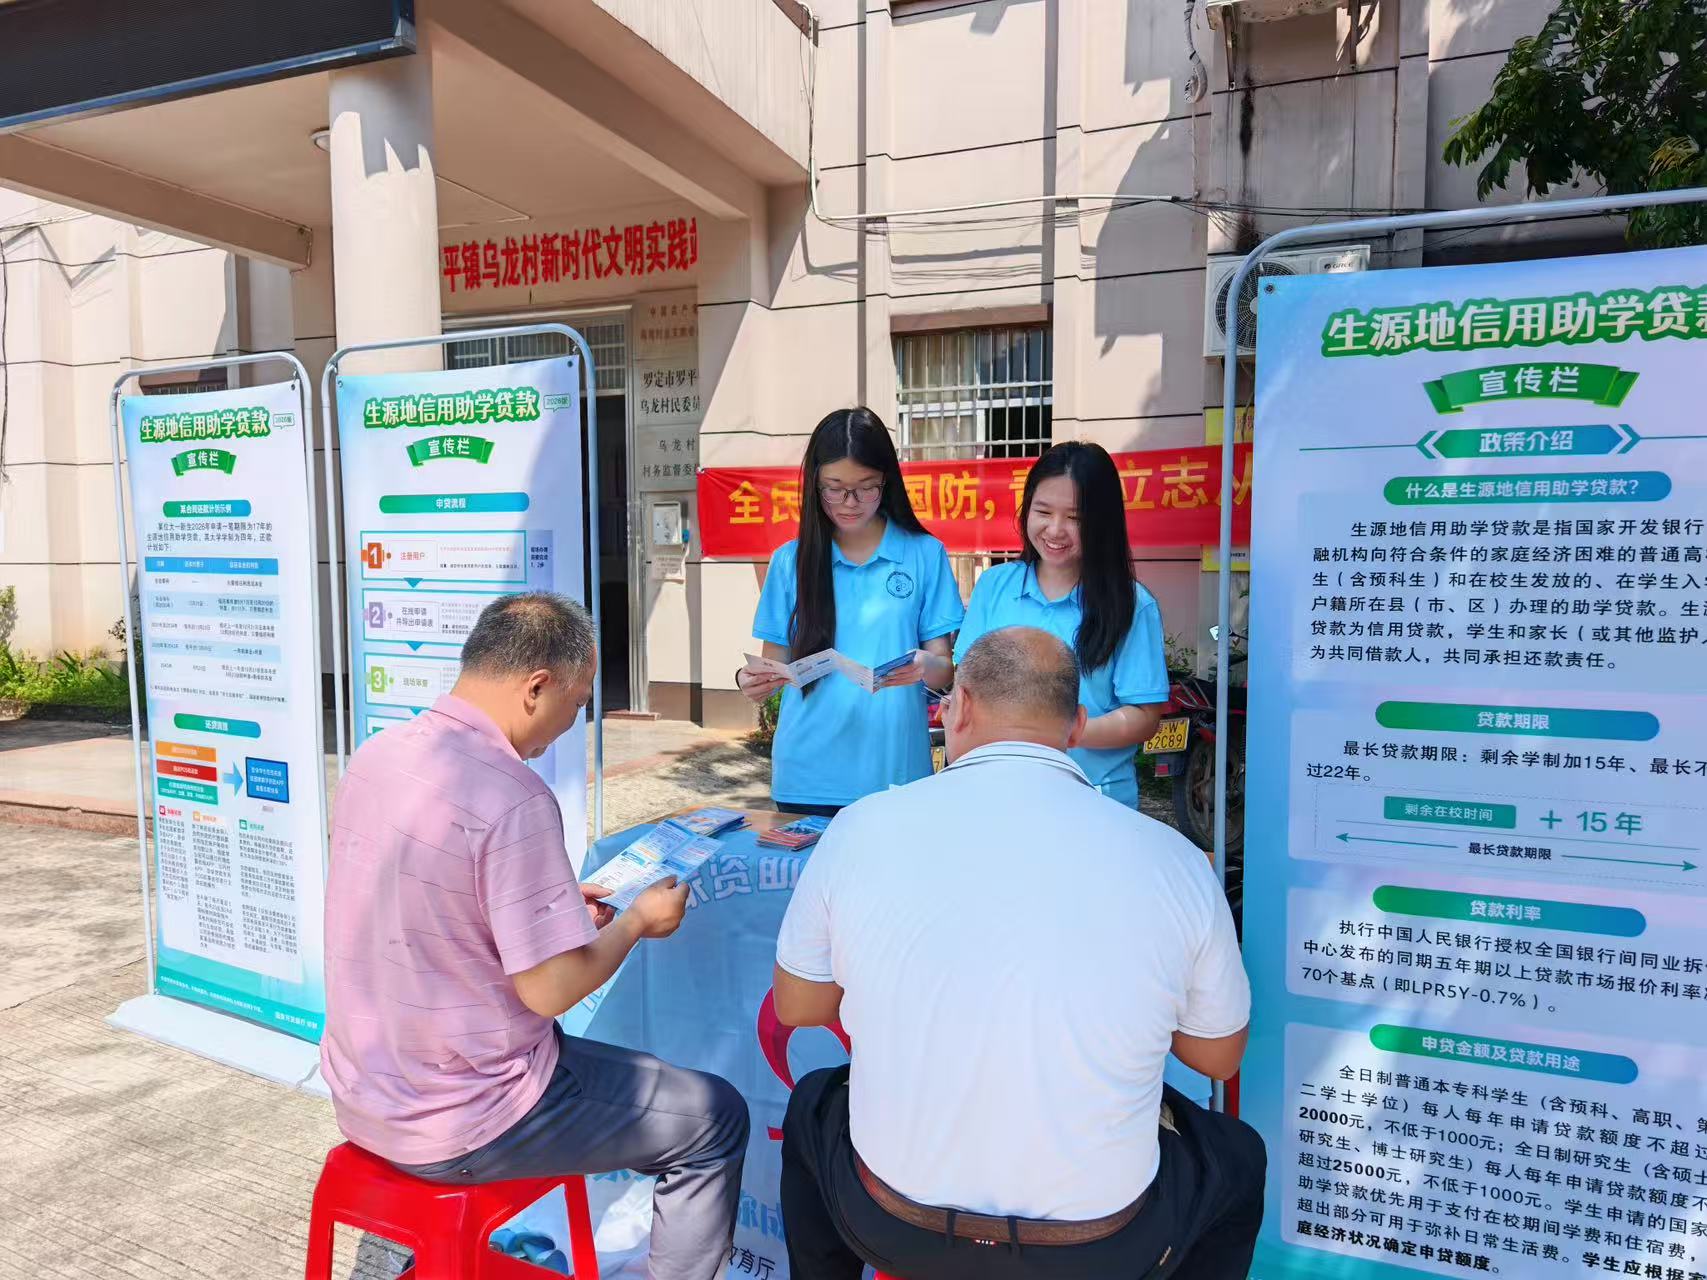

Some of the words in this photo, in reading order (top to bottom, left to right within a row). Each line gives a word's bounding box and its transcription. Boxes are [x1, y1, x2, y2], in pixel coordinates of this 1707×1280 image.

[1478, 365, 1580, 398] 宣传栏
[365, 389, 538, 426] 生源地信用助学贷款
[141, 410, 269, 440] 生源地信用助学贷款
[428, 437, 470, 457] 宣传栏
[1479, 430, 1574, 454] 政策介绍
[187, 451, 219, 467] 宣传栏
[1405, 478, 1640, 500] 什么是生源地信用助学贷款？
[435, 497, 467, 509] 申贷流程
[1350, 518, 1704, 538] 生源地信用助学贷款是指国家开发银行
[370, 547, 378, 565] 1
[371, 606, 381, 624] 2
[1309, 645, 1616, 669] 为共同借款人，共同承担还款责任。
[374, 671, 382, 688] 3
[1476, 710, 1550, 731] 贷款期限
[1146, 733, 1183, 750] 62C89
[1306, 763, 1372, 783] 过22年。
[1404, 802, 1493, 822] 剩余在校时间
[1468, 842, 1551, 861] 最长贷款期限
[1469, 899, 1542, 921] 贷款利率
[1338, 920, 1707, 976] 执行中国人民银行授权全国银行间同业拆
[1303, 939, 1707, 1001] 中心发布的同期五年期以上贷款市场报价利率
[1421, 1035, 1581, 1072] 申贷金额及贷款用途
[1297, 1174, 1698, 1263] 助学贷款优先用于支付在校期间学费和住宿费，
[1296, 1219, 1503, 1275] 庭经济状况确定申贷额度。
